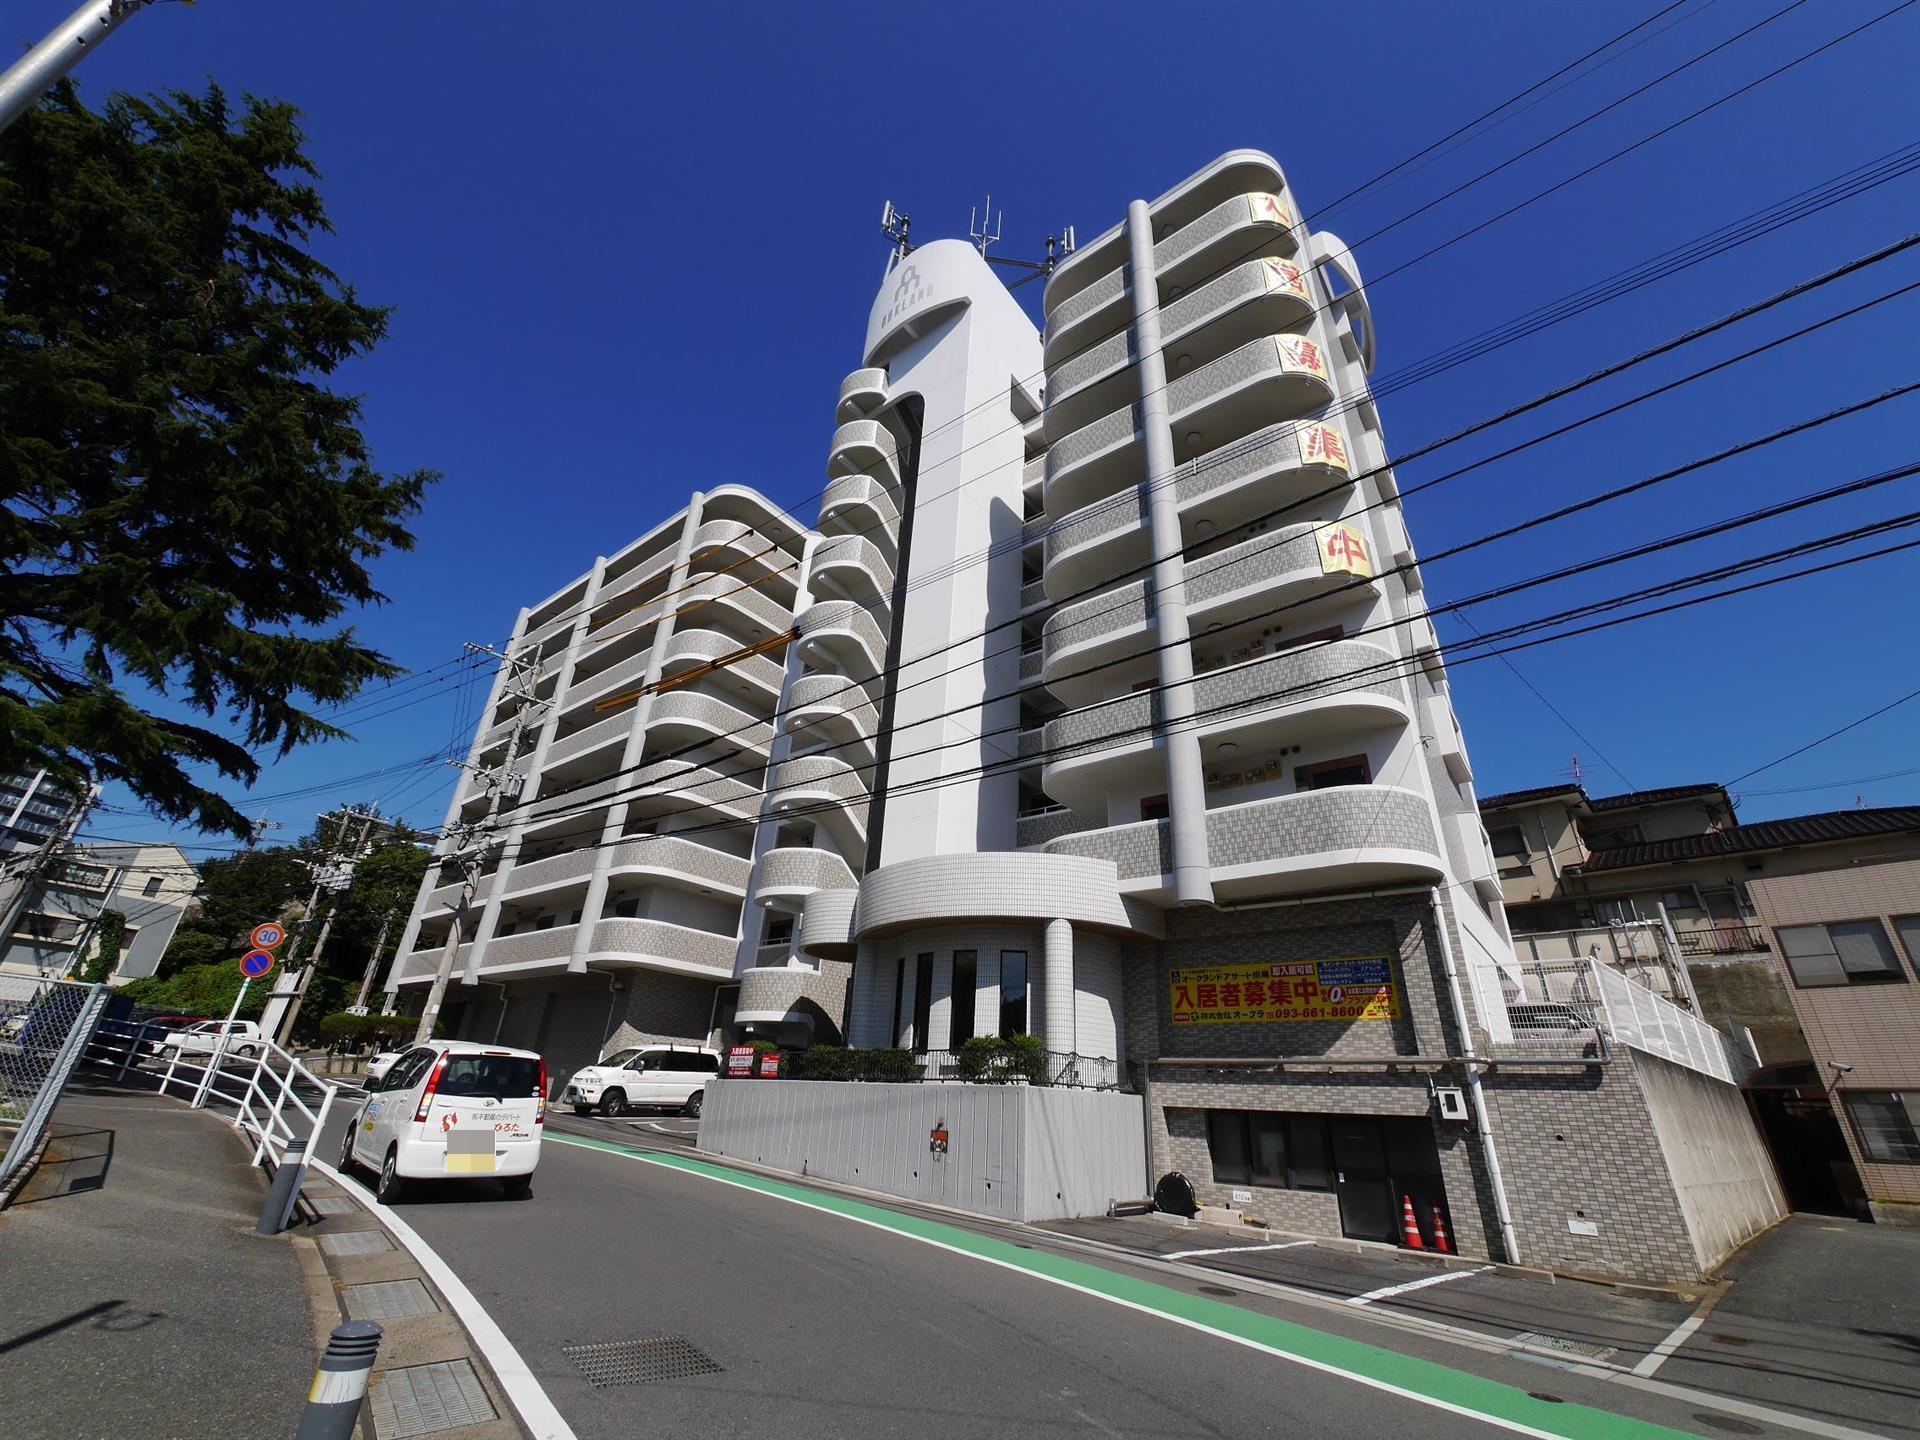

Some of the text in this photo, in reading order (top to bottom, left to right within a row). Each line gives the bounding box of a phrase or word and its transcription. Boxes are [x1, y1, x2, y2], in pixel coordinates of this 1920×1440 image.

[258, 930, 278, 943] 30
[1174, 978, 1319, 1009] 入居者募集中
[1275, 1006, 1363, 1019] 093-661-8600
[494, 1123, 519, 1132] ひろた
